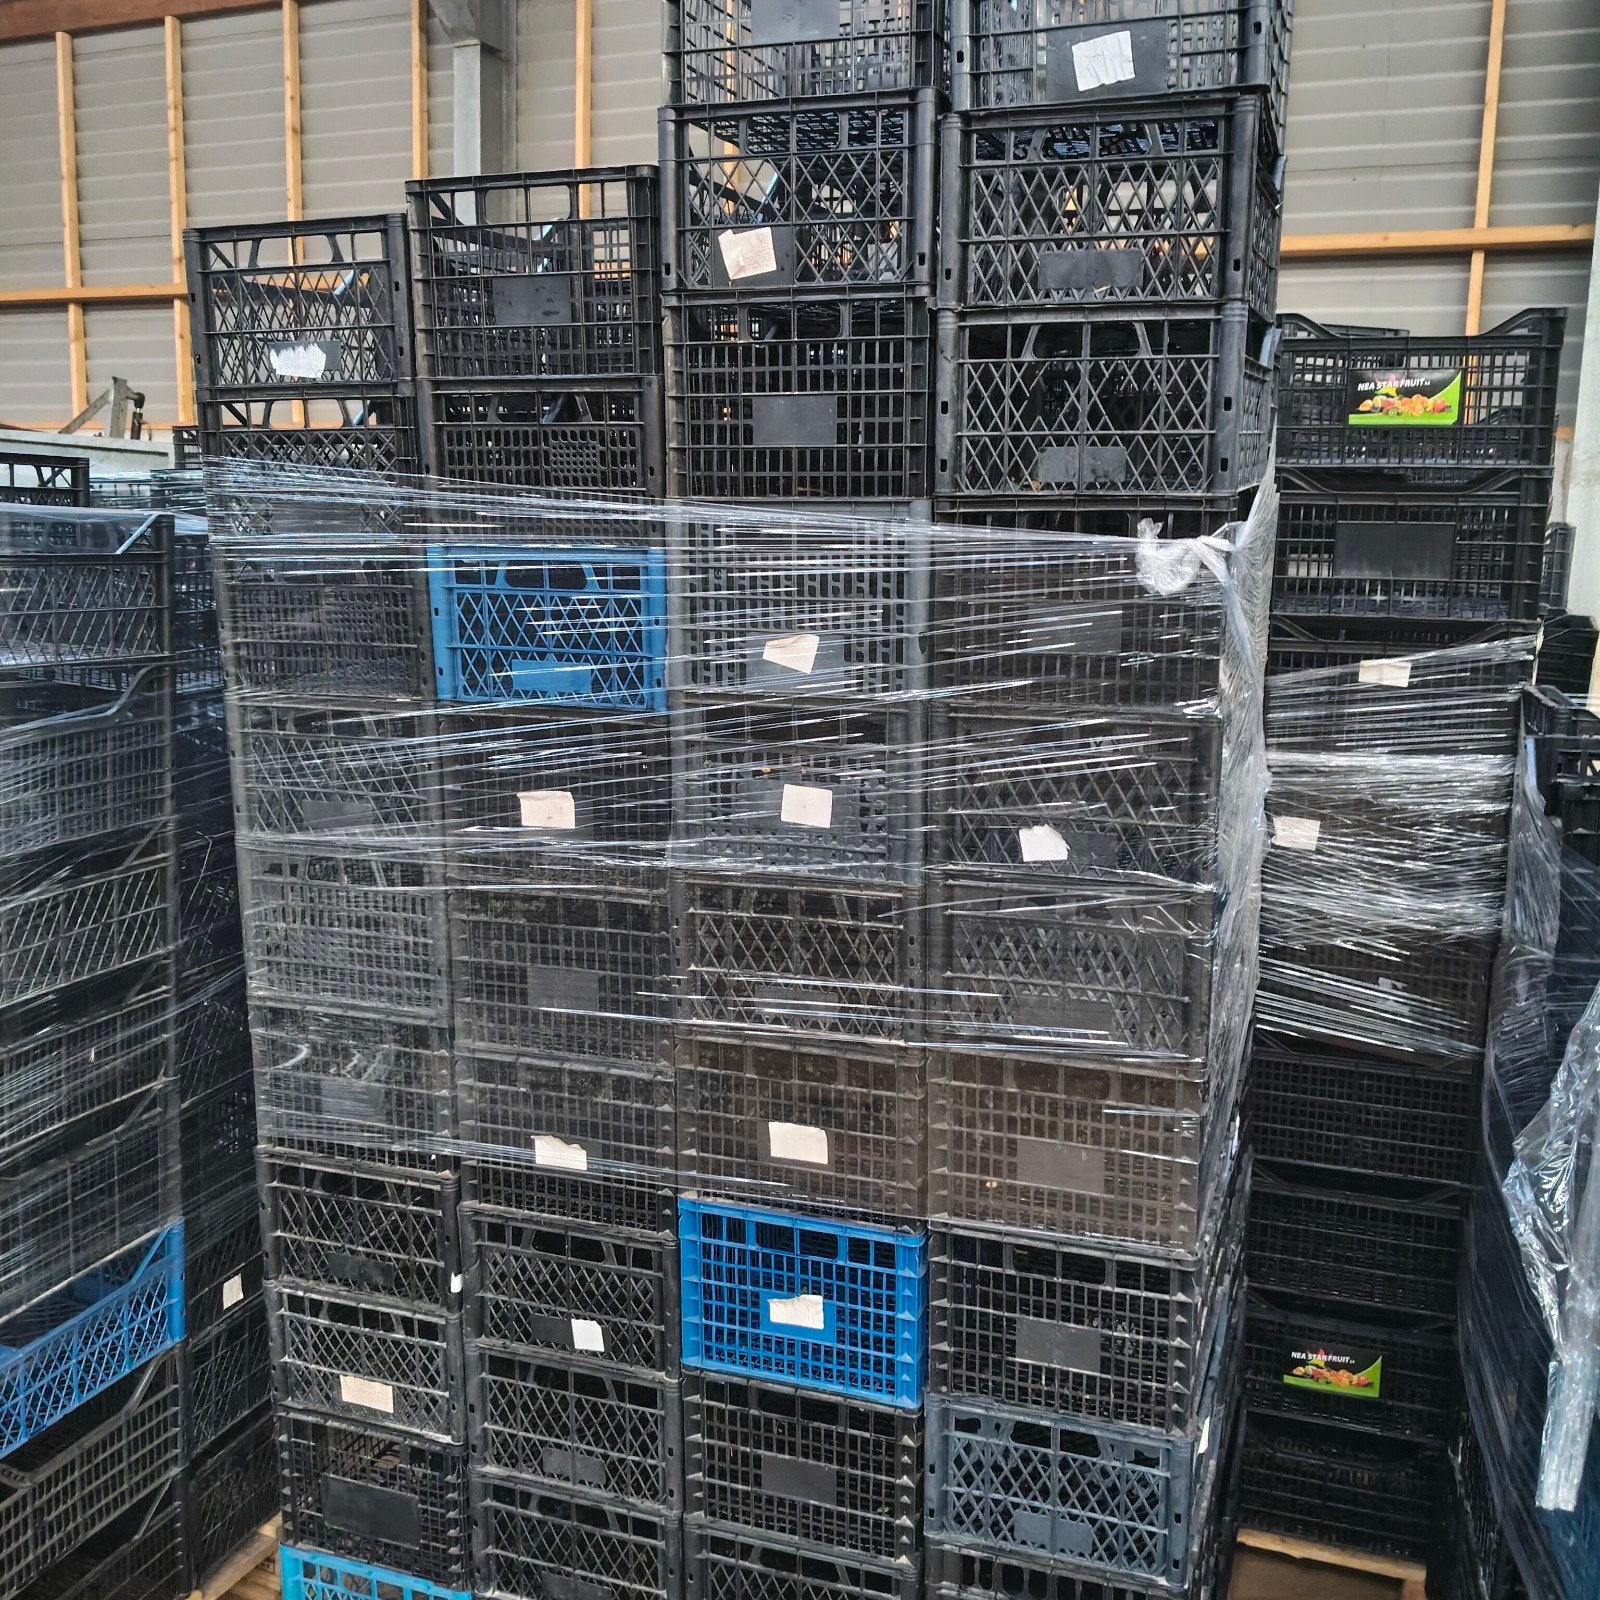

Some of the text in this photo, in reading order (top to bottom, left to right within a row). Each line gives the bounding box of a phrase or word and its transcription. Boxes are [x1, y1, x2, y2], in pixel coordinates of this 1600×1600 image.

[1358, 383, 1375, 391] NEA
[1377, 380, 1398, 389] STAR
[1399, 378, 1425, 387] FRUIT
[1307, 1353, 1327, 1361] STAR
[1328, 1355, 1350, 1363] FRUIT
